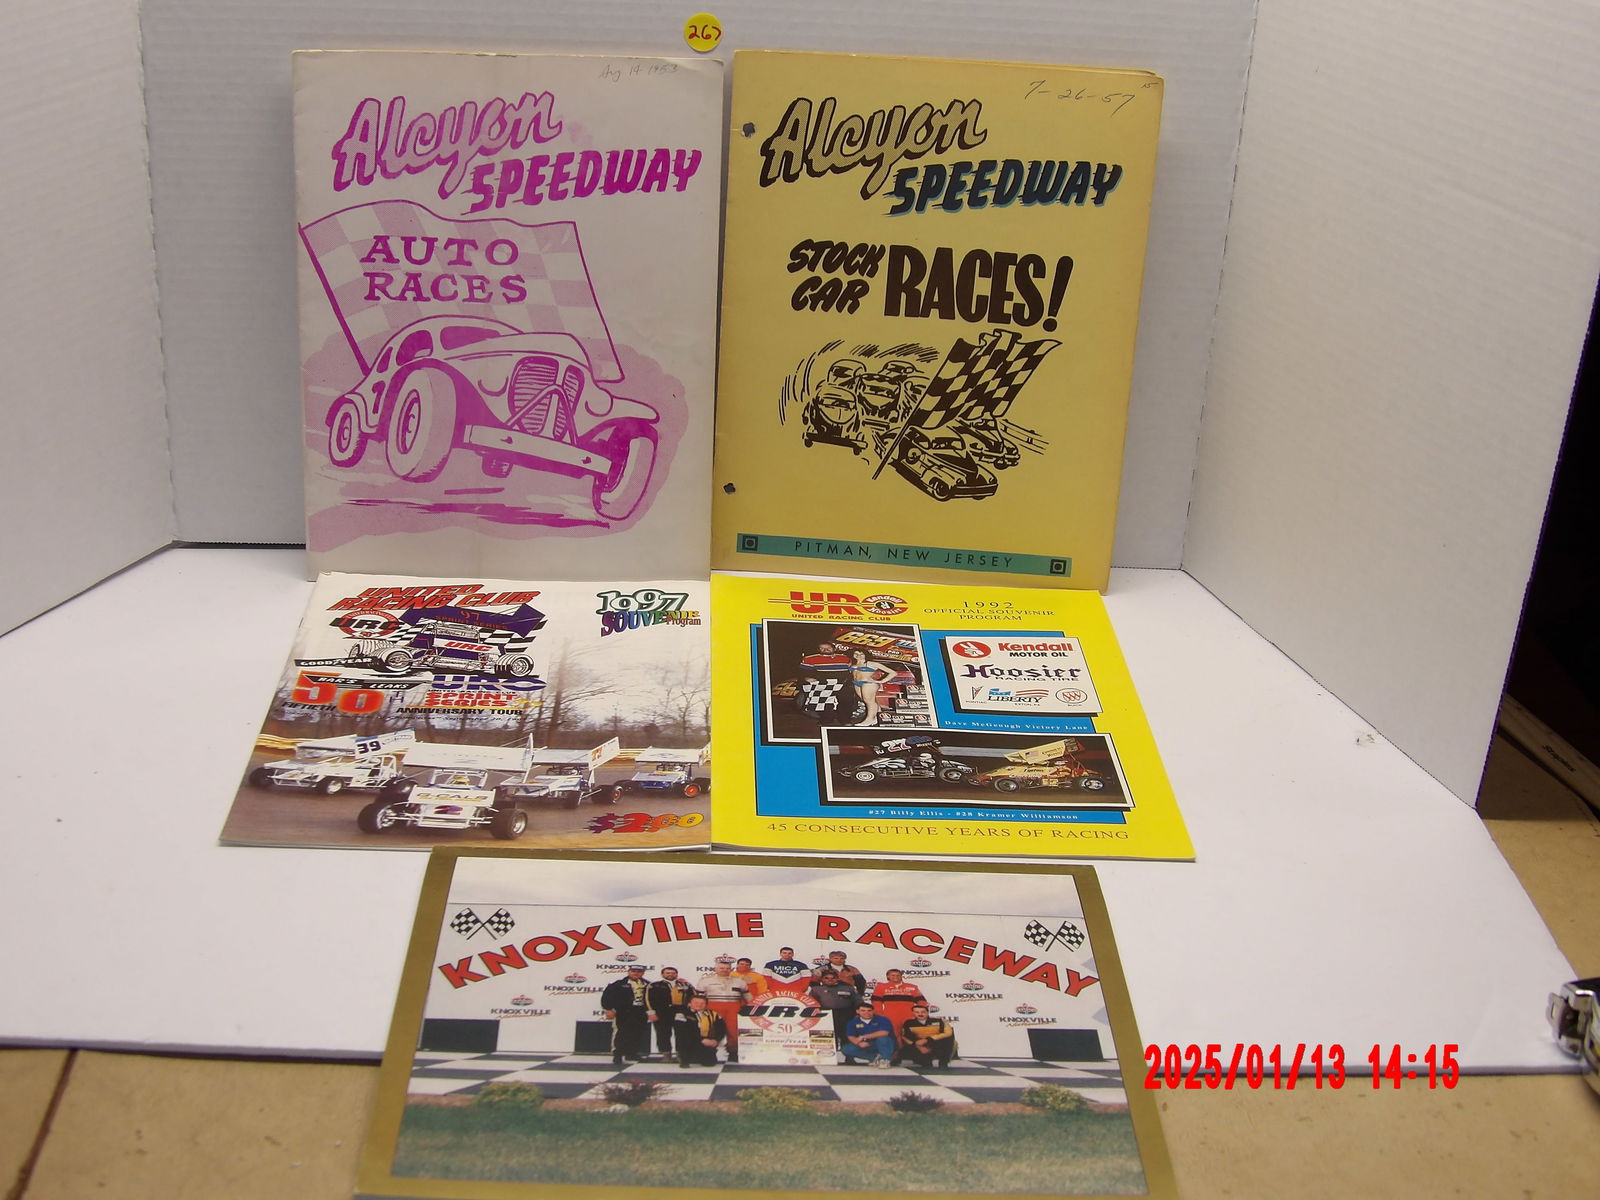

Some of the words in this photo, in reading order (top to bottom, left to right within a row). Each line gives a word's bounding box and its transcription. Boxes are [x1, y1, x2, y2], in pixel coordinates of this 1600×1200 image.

[688, 24, 722, 41] 267
[332, 91, 562, 199] Alcyon
[759, 97, 988, 200] Alcyon
[461, 149, 701, 214] SPEEDWAY
[883, 159, 1123, 216] SPEEDWAY
[360, 235, 519, 266] AUTO
[787, 239, 886, 279] STOCK
[363, 272, 527, 303] RACES
[791, 276, 870, 315] CAR
[884, 244, 1074, 332] RACES!
[795, 541, 871, 559] PITMAN,
[887, 548, 930, 560] NEW
[944, 552, 1013, 567] JERSEY
[357, 584, 485, 598] UNITED
[326, 594, 457, 610] RACING
[455, 591, 541, 607] CLUB
[596, 589, 689, 615] 1997
[962, 601, 1014, 609] 1992
[600, 610, 700, 637] SOUVENIR
[666, 615, 701, 627] Program
[444, 641, 493, 651] URC
[998, 643, 1073, 651] Kendall
[960, 664, 1081, 678] Hoosier
[425, 692, 518, 700] SPRINT
[425, 699, 508, 707] SERIES
[281, 702, 337, 711] FIFTIETH
[396, 707, 485, 715] ANNIVERSARY
[357, 740, 381, 754] 39
[882, 738, 912, 752] 27
[794, 824, 939, 835] CONSECUTIVE
[945, 827, 1011, 837] YEARS
[1018, 829, 1044, 837] OF
[1052, 829, 1129, 840] RACING
[438, 911, 765, 989] KNOXVILLE
[816, 915, 1101, 997] RACEWAY
[739, 1005, 828, 1017] URC
